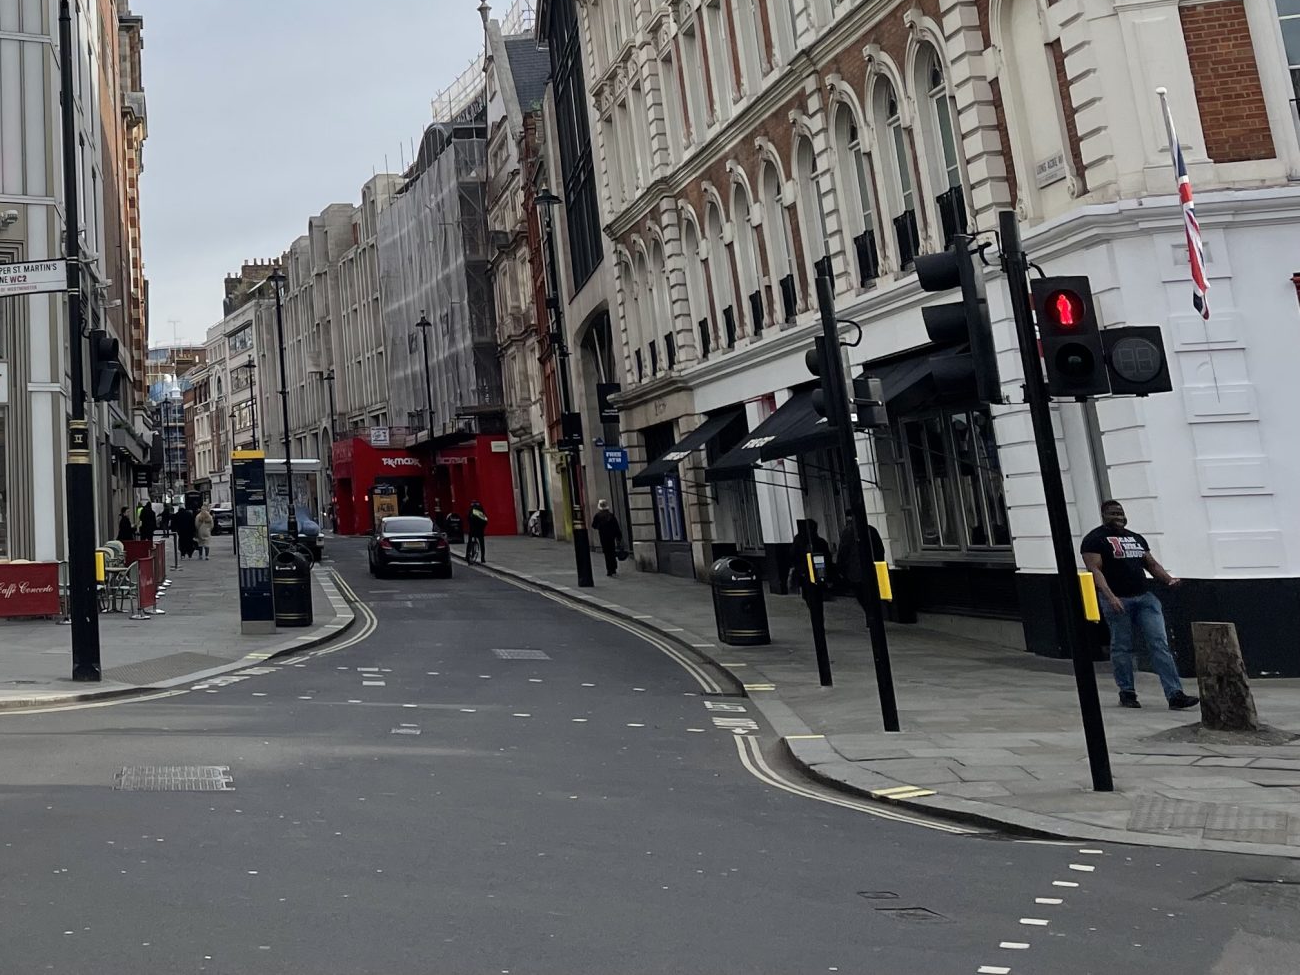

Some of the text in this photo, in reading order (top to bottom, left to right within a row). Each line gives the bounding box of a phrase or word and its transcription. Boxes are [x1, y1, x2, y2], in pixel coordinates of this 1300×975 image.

[23, 263, 57, 273] MARTIN'S
[9, 275, 27, 284] WC2
[19, 581, 54, 594] Concerto
